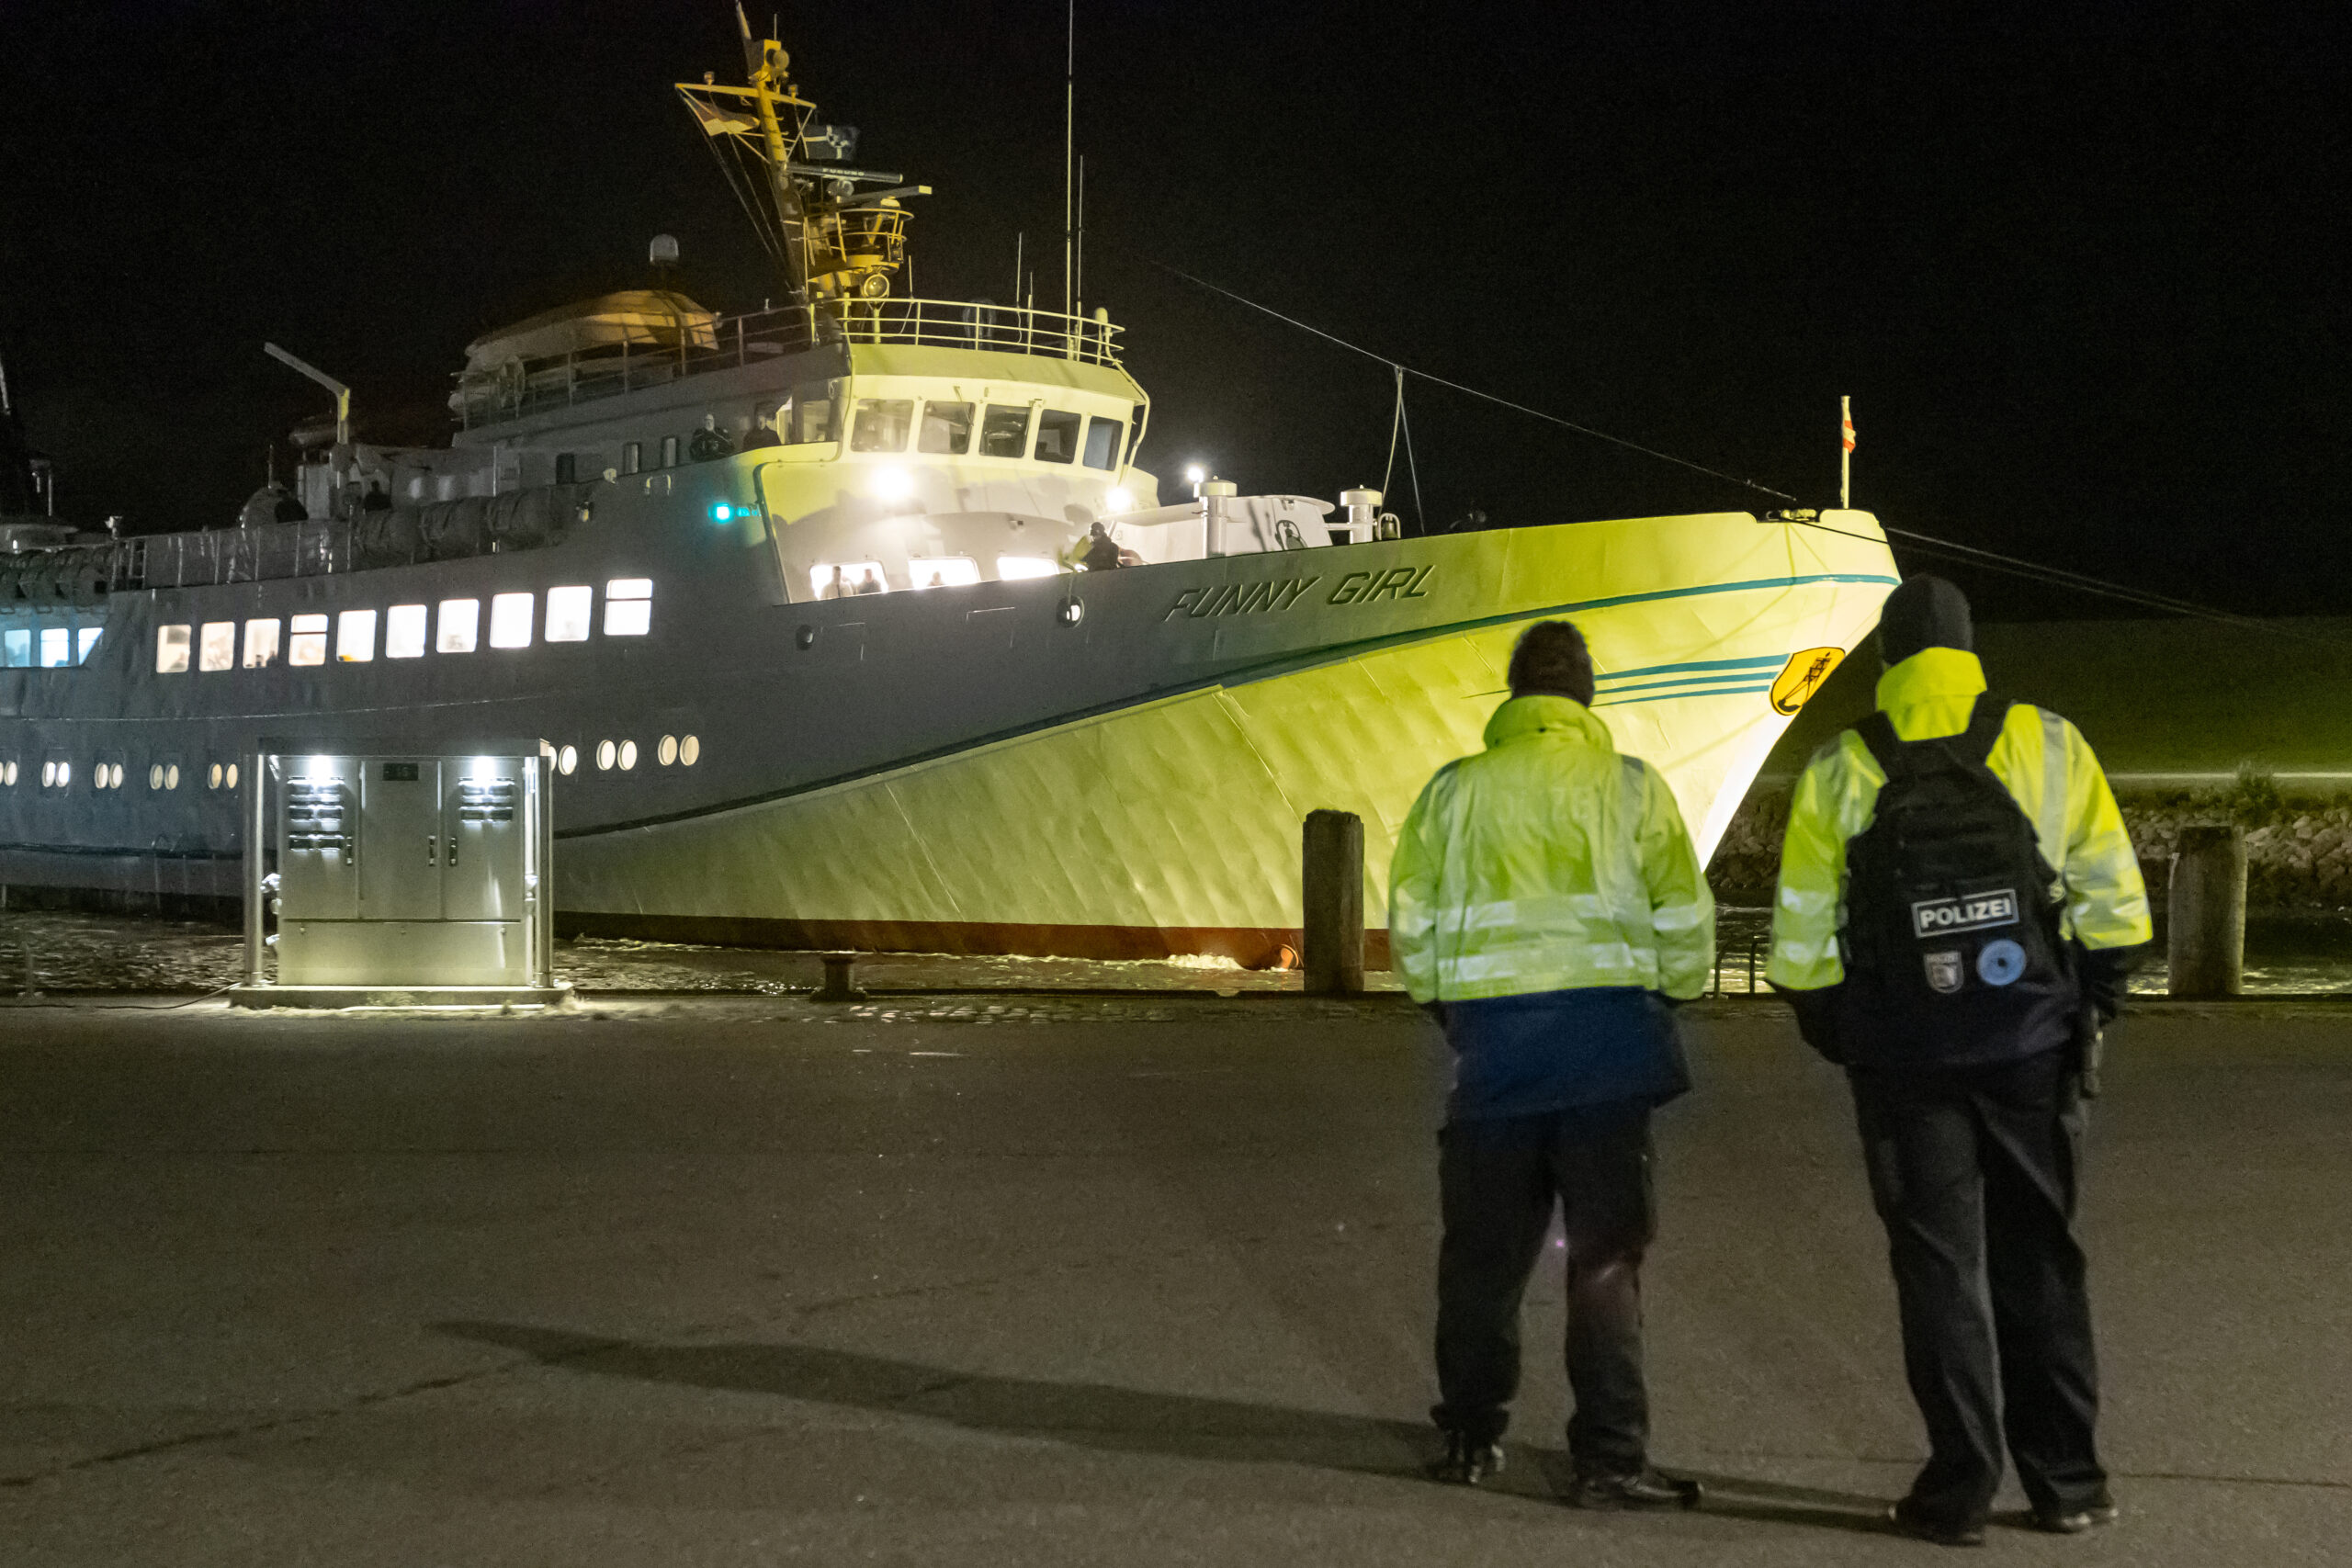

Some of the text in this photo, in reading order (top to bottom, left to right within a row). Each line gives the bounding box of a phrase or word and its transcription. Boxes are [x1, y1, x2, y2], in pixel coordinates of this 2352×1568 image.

[1162, 564, 1436, 623] FUNNY GIRL
[1919, 897, 2011, 929] POLIZEI
